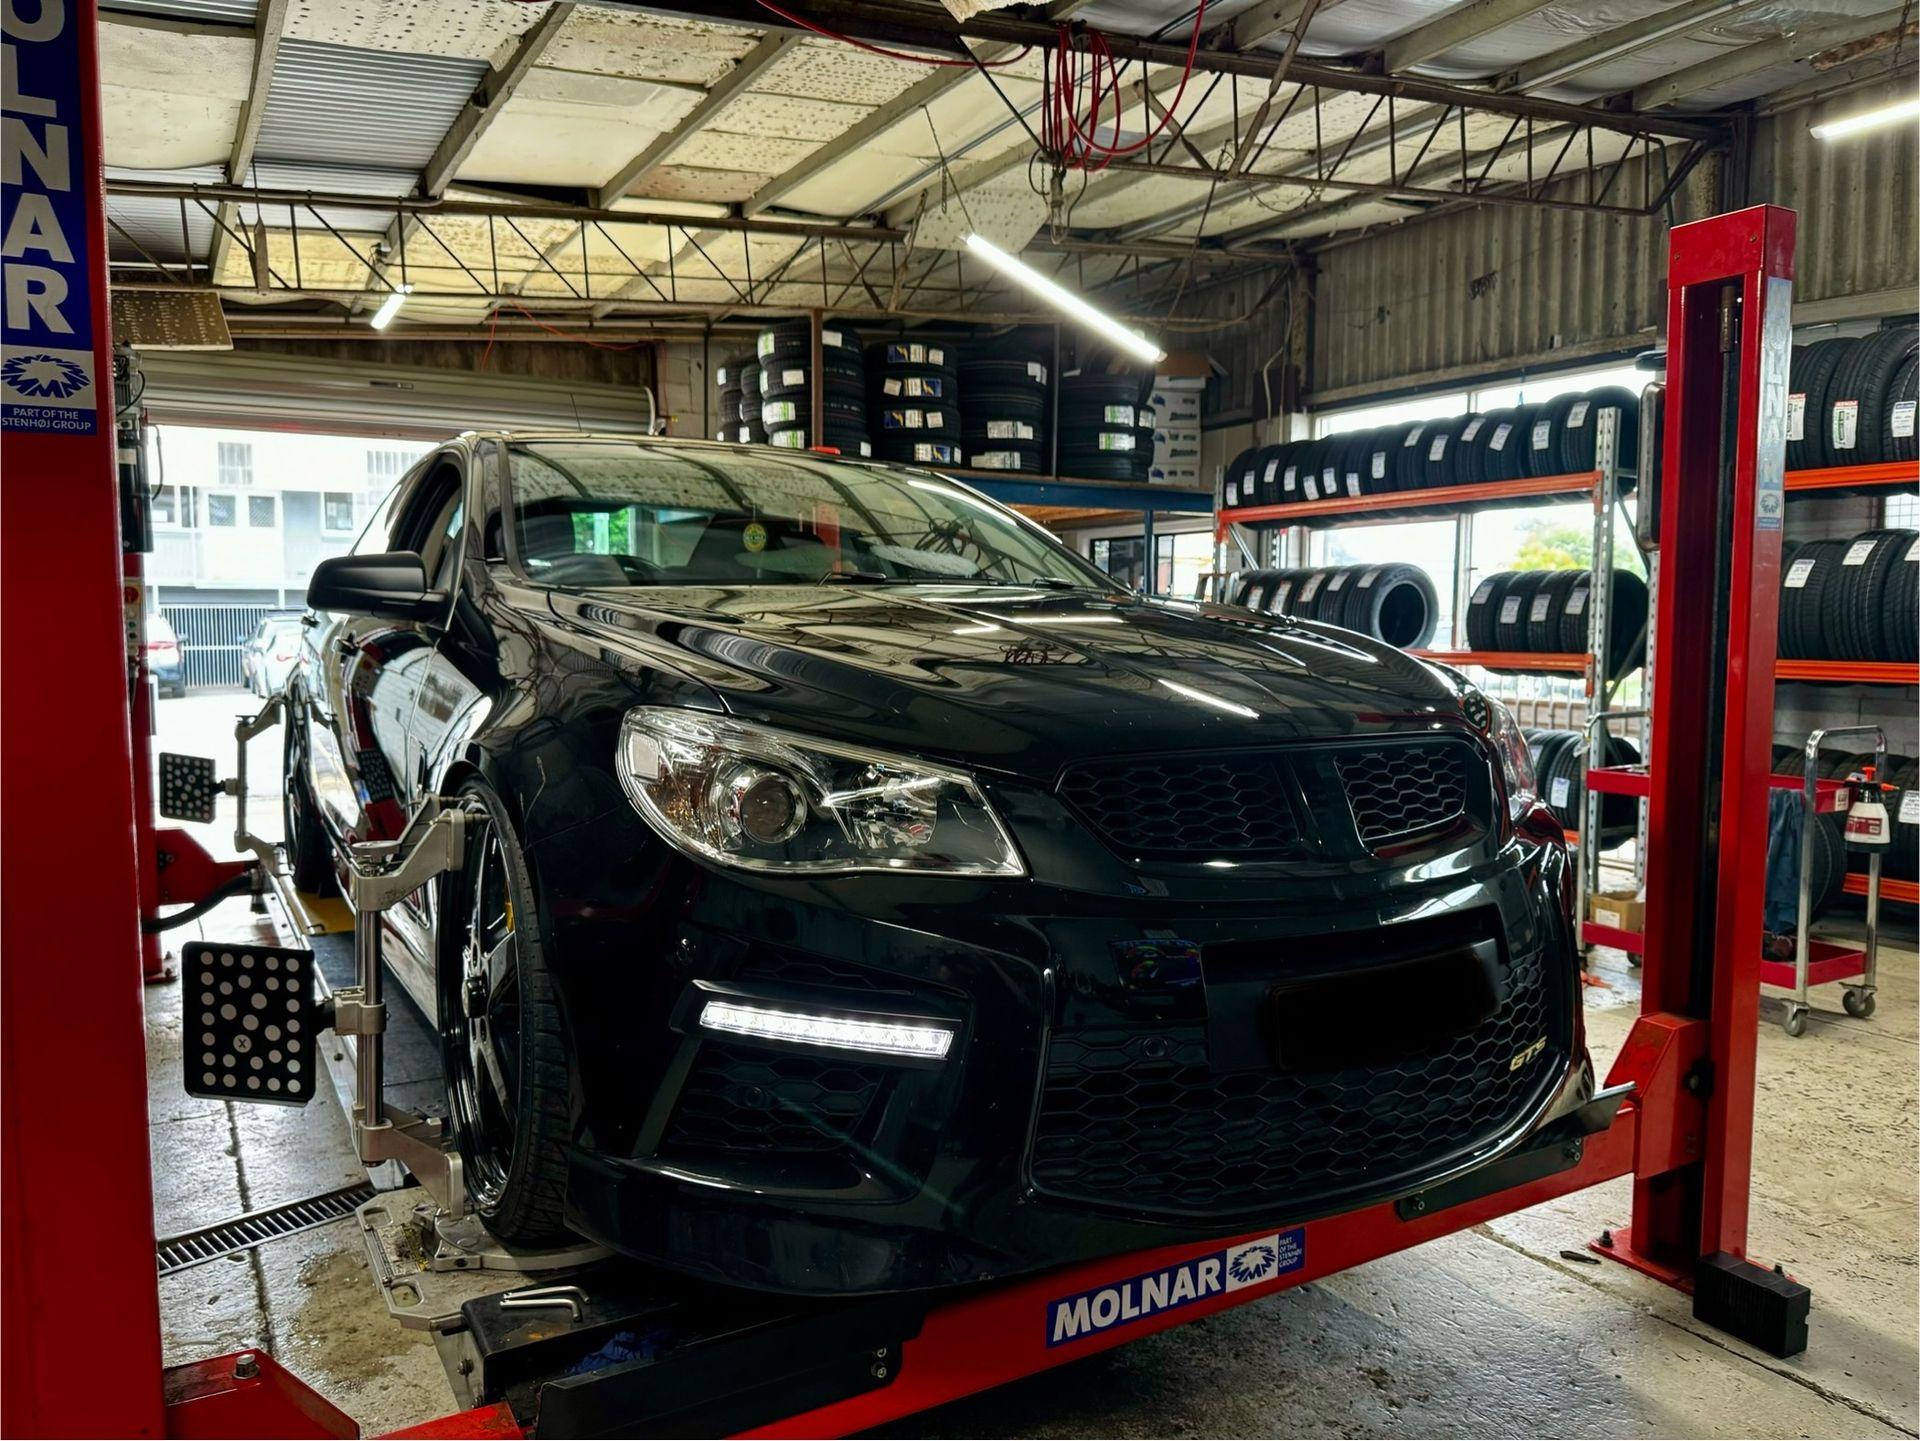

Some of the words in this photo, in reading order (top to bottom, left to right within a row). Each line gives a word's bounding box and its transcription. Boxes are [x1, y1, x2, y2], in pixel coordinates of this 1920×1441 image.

[13, 407, 40, 417] PART
[42, 409, 57, 418] OF
[58, 410, 79, 420] THE
[52, 420, 91, 430] GROUP
[1053, 1258, 1222, 1342] MOLNAR
